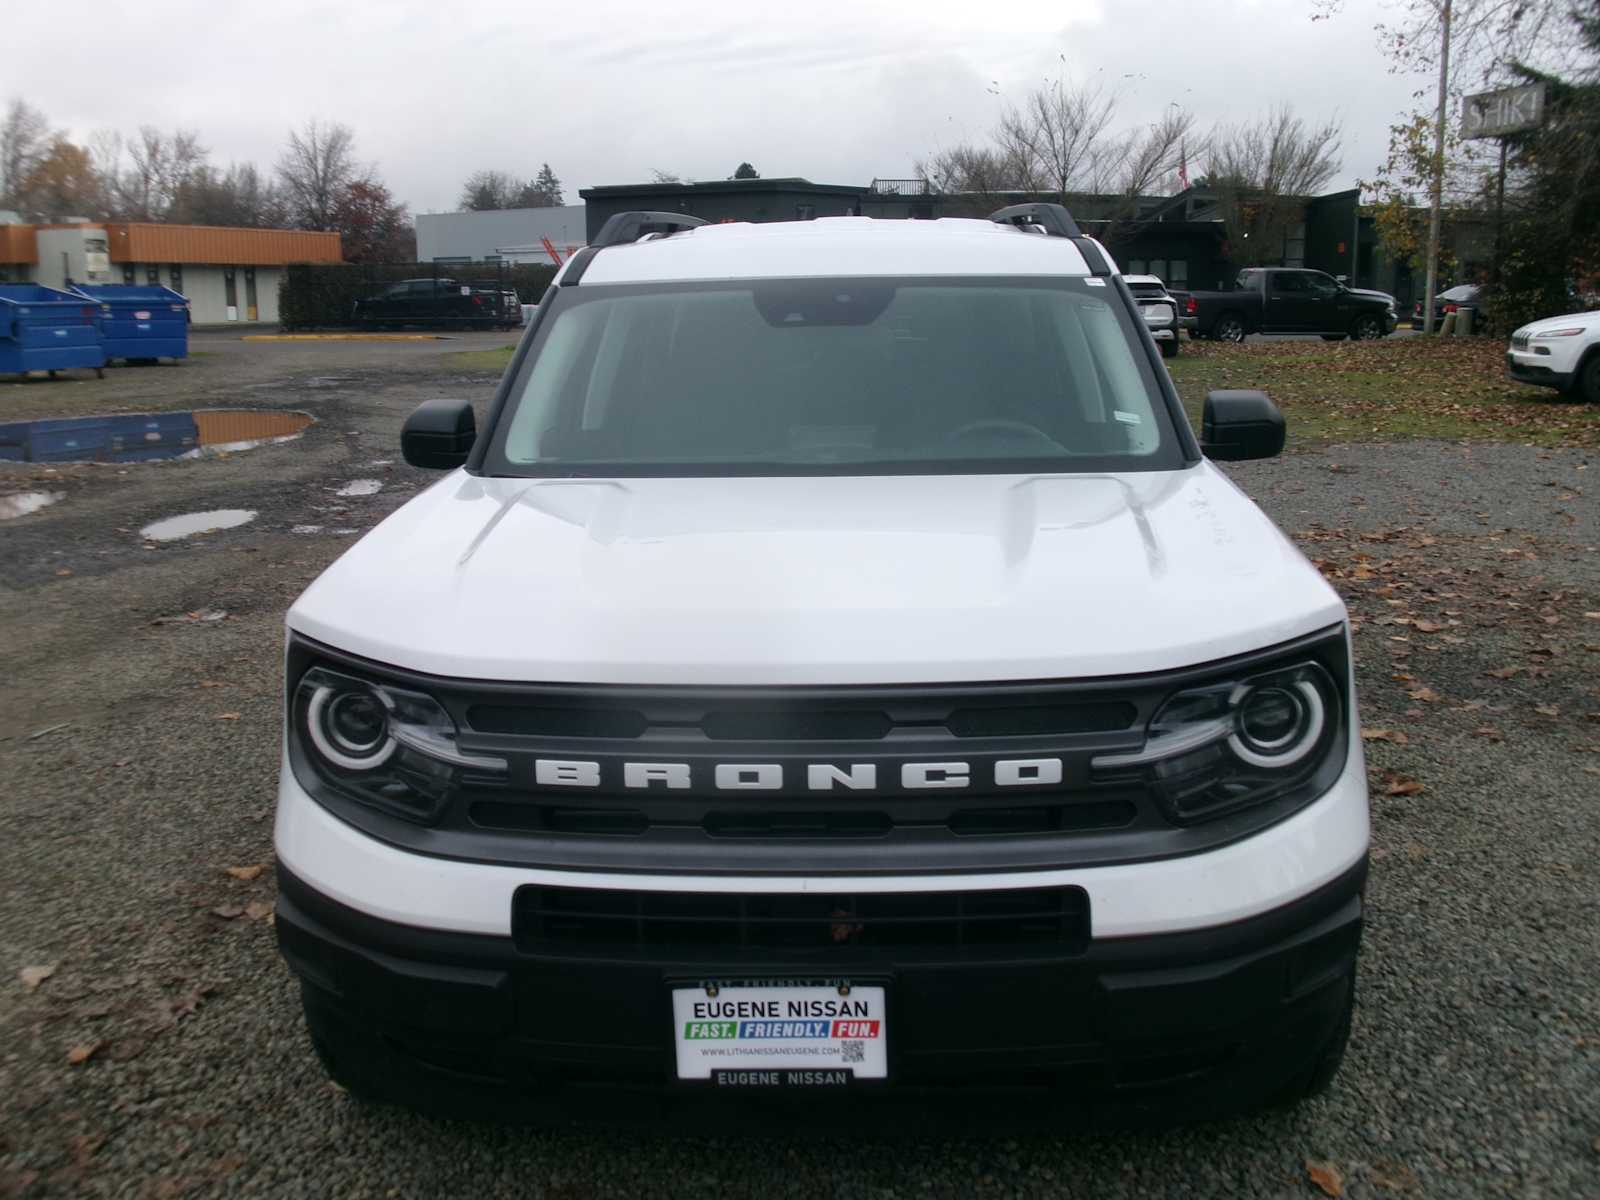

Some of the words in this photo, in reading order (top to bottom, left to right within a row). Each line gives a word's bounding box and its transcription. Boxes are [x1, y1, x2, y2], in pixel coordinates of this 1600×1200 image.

[1469, 92, 1537, 129] SHIKI
[535, 758, 1063, 790] BRONCO
[694, 1001, 780, 1018] EUGENE
[788, 1000, 868, 1017] NISSAN
[690, 1022, 733, 1038] FAST.
[744, 1021, 826, 1038] FRIENDLY.
[837, 1021, 876, 1037] FUN.
[718, 1072, 780, 1085] EUGENE
[788, 1072, 847, 1085] NISSAN
